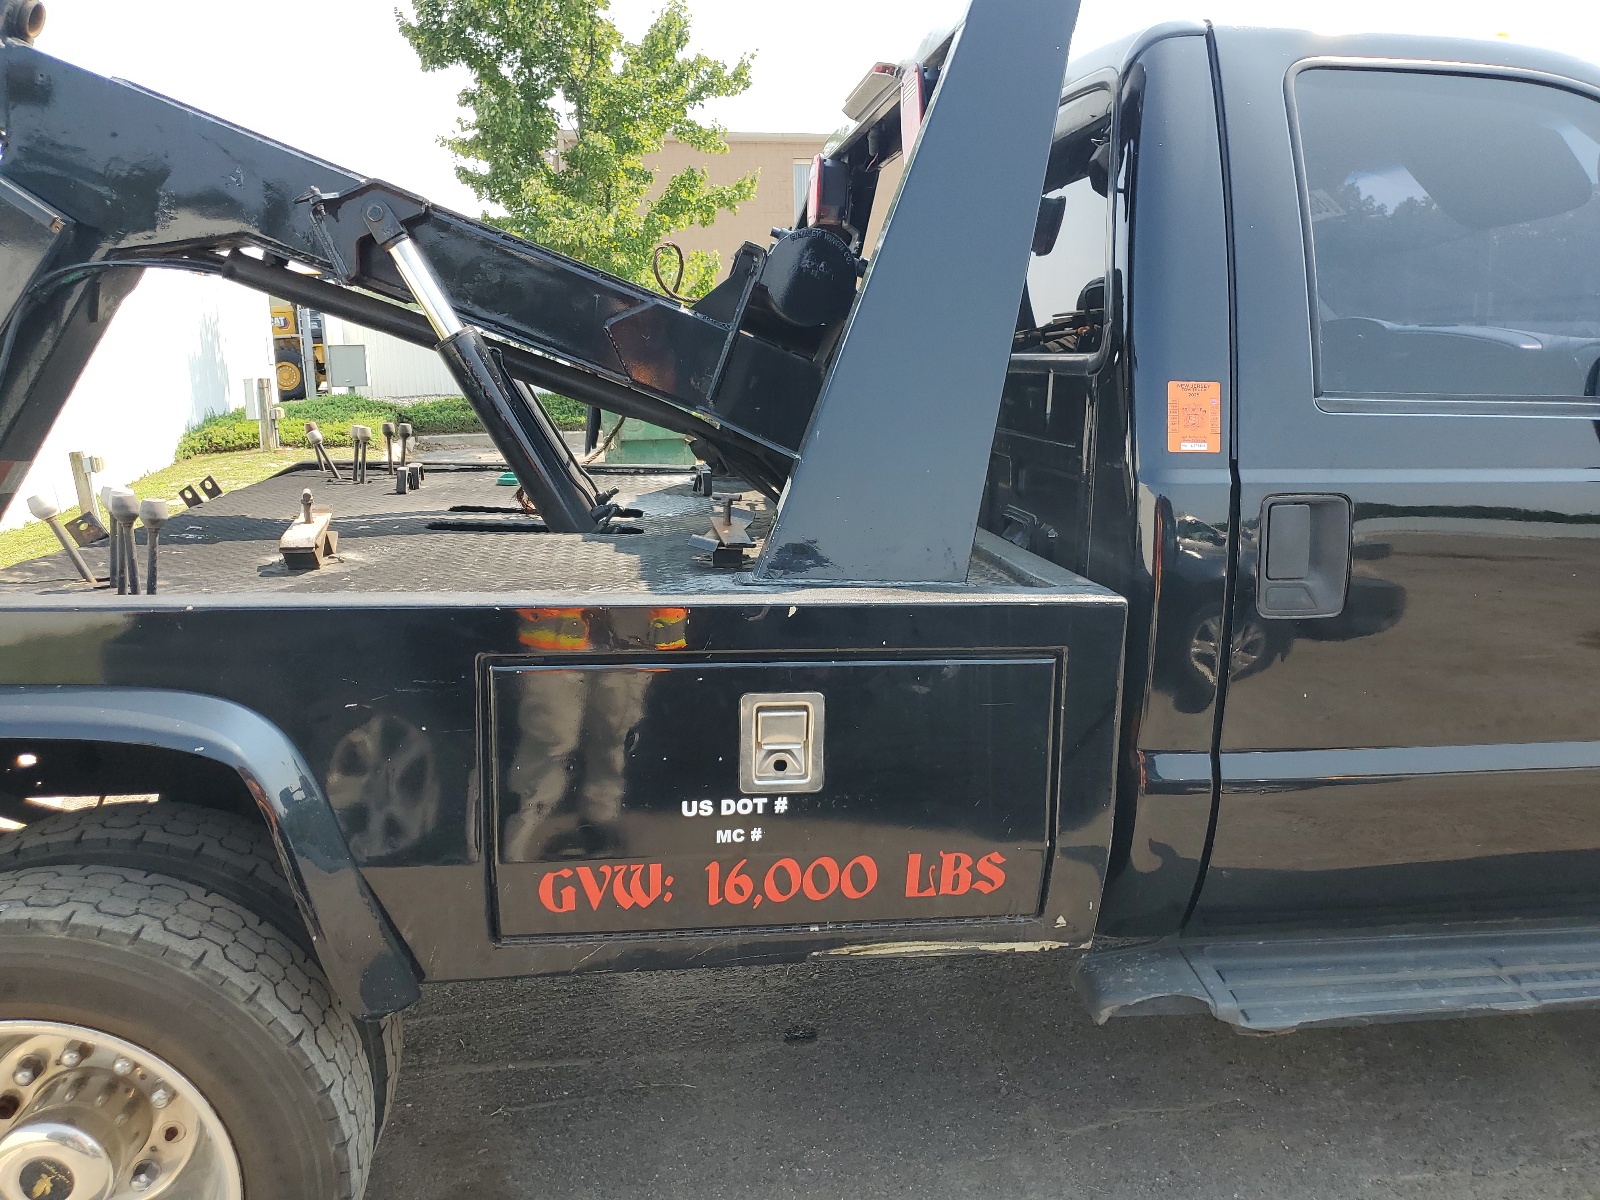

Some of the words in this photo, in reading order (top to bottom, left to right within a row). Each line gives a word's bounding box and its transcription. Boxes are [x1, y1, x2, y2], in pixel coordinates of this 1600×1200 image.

[682, 800, 713, 816] US
[721, 798, 767, 815] DOT
[775, 797, 787, 813] #
[717, 829, 745, 843] MC
[751, 828, 762, 841] #
[538, 863, 674, 912] GVW:
[704, 855, 878, 908] 16,000
[906, 851, 1005, 897] LBS
